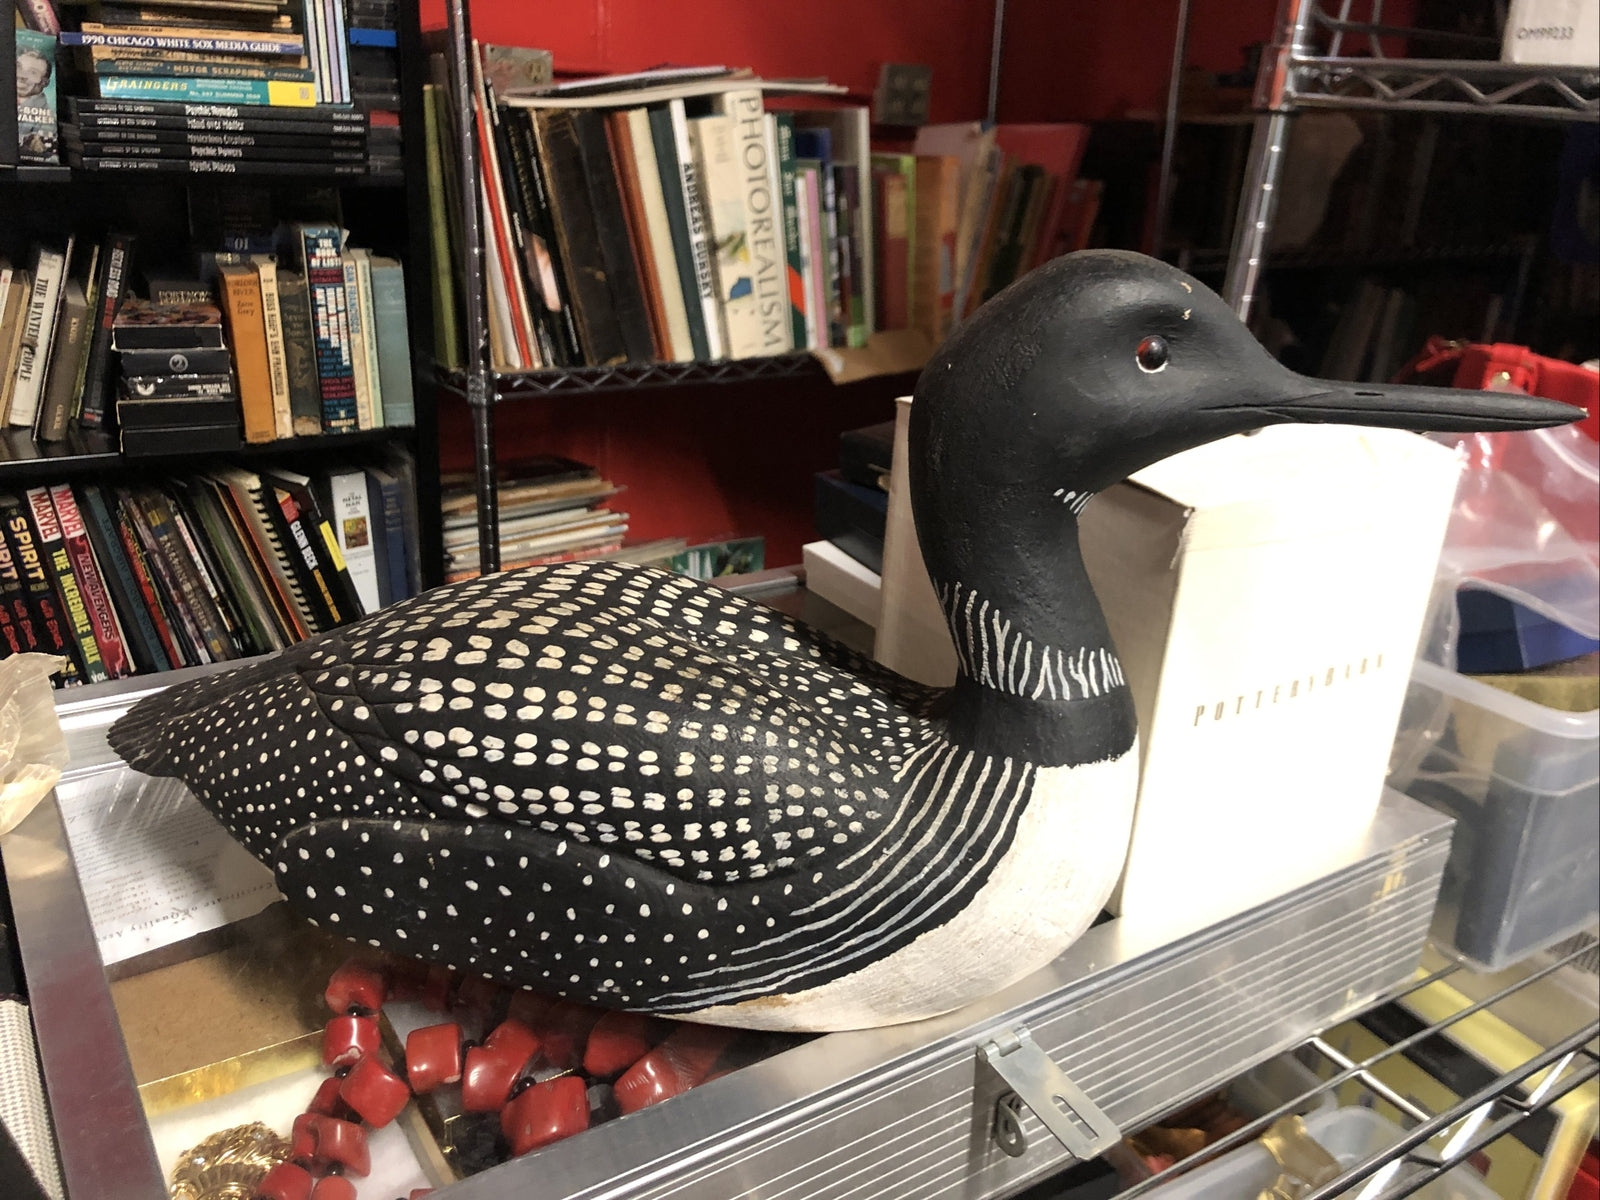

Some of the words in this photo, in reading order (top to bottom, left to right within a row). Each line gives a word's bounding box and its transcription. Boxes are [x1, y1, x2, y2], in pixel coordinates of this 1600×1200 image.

[82, 34, 105, 45] 1990
[107, 36, 154, 47] CHICAGO
[156, 38, 190, 48] WHITE
[193, 40, 213, 49] SOX
[216, 40, 248, 50] MEDIA
[251, 42, 281, 52] GUIDE
[106, 76, 188, 91] GRAINGERS
[18, 106, 52, 116] -BONE
[683, 162, 702, 235] ANDREAS
[695, 236, 714, 299] GURSKY
[740, 96, 782, 349] PHOTOREALISM
[35, 278, 48, 298] THE
[30, 492, 60, 540] MARVEL
[53, 488, 84, 538] MARVEL
[0, 530, 18, 580] IRIT
[10, 516, 45, 580] SPIRIT
[53, 548, 70, 572] THE
[290, 520, 308, 549] GLENN
[302, 546, 318, 570] BECK
[60, 573, 91, 634] INCREDIBLE
[80, 554, 96, 586] NEW
[88, 582, 115, 642] AVENGERS
[81, 636, 101, 665] HULK
[130, 911, 180, 932] Quality
